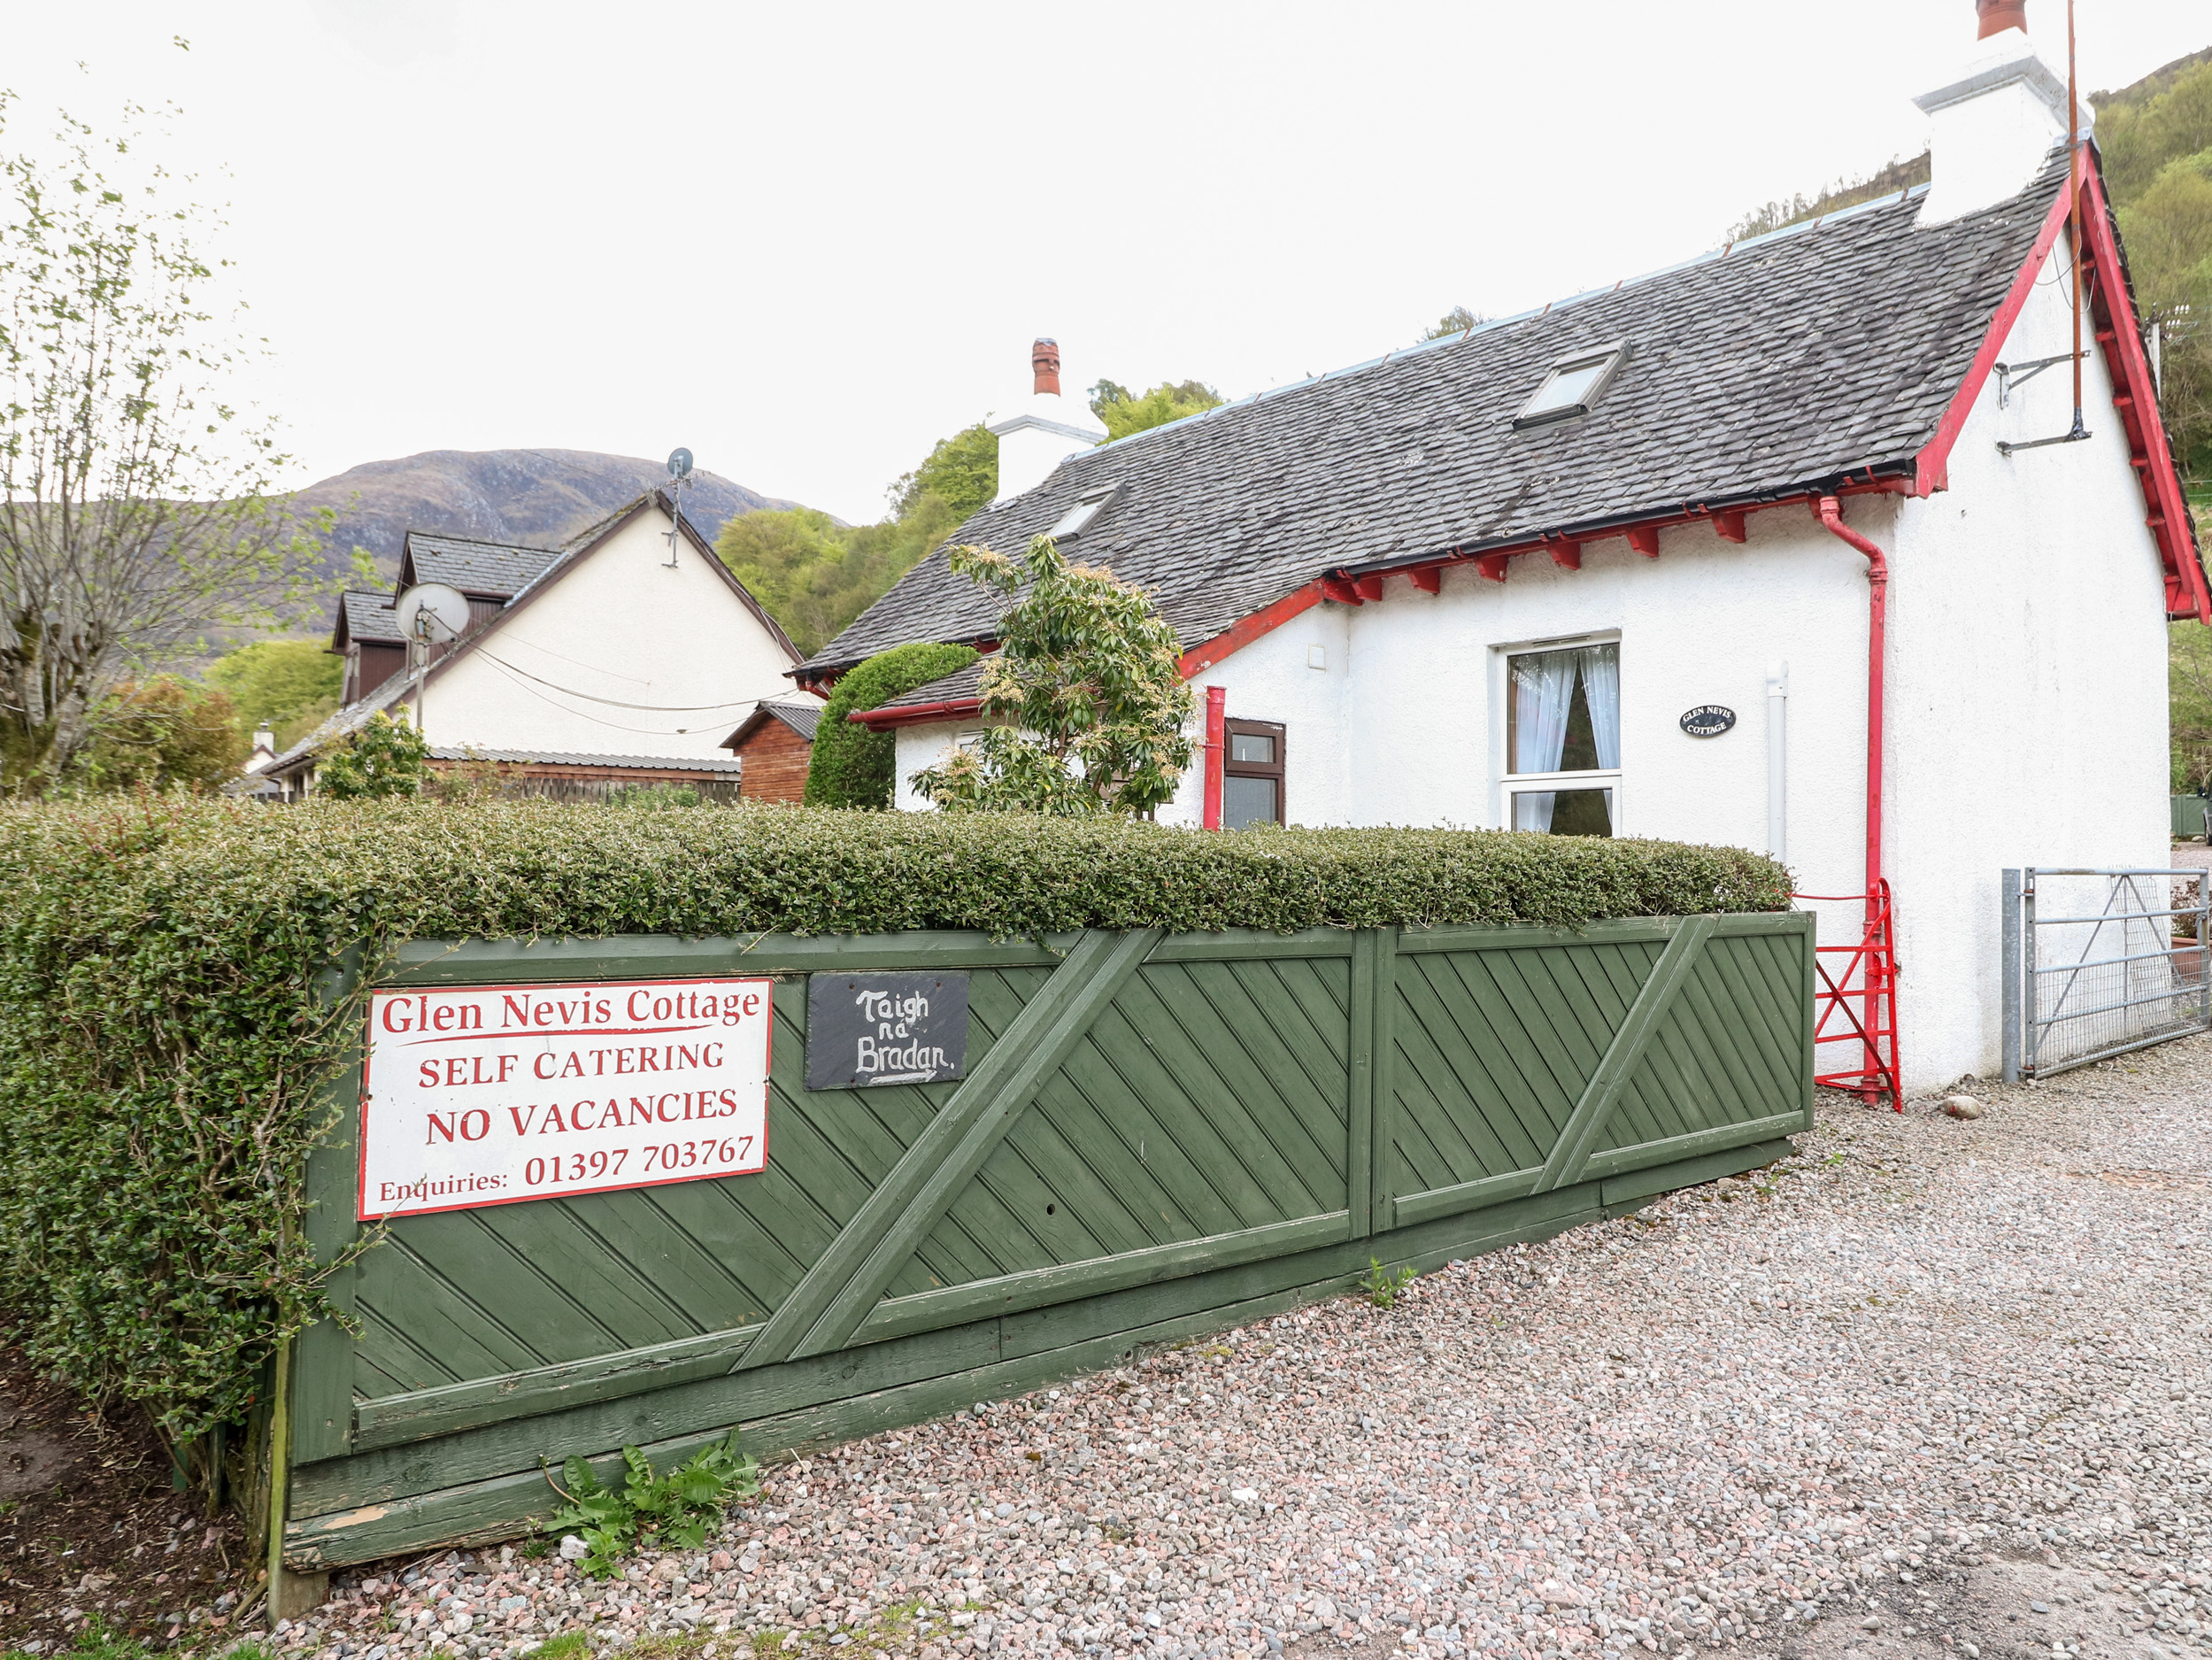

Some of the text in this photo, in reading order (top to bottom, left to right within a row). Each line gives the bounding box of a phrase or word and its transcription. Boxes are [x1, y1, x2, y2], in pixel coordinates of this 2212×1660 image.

[1683, 706, 1731, 722] GLEN NEVIS
[1687, 722, 1727, 735] COTTAGE
[382, 990, 759, 1034] Glen Nevis Cottage
[855, 990, 929, 1024] Taigh
[419, 1042, 724, 1088] SELF CATERING
[426, 1089, 737, 1146] NO VACANCIES
[379, 1135, 754, 1203] Enquiries: 01397 703767
